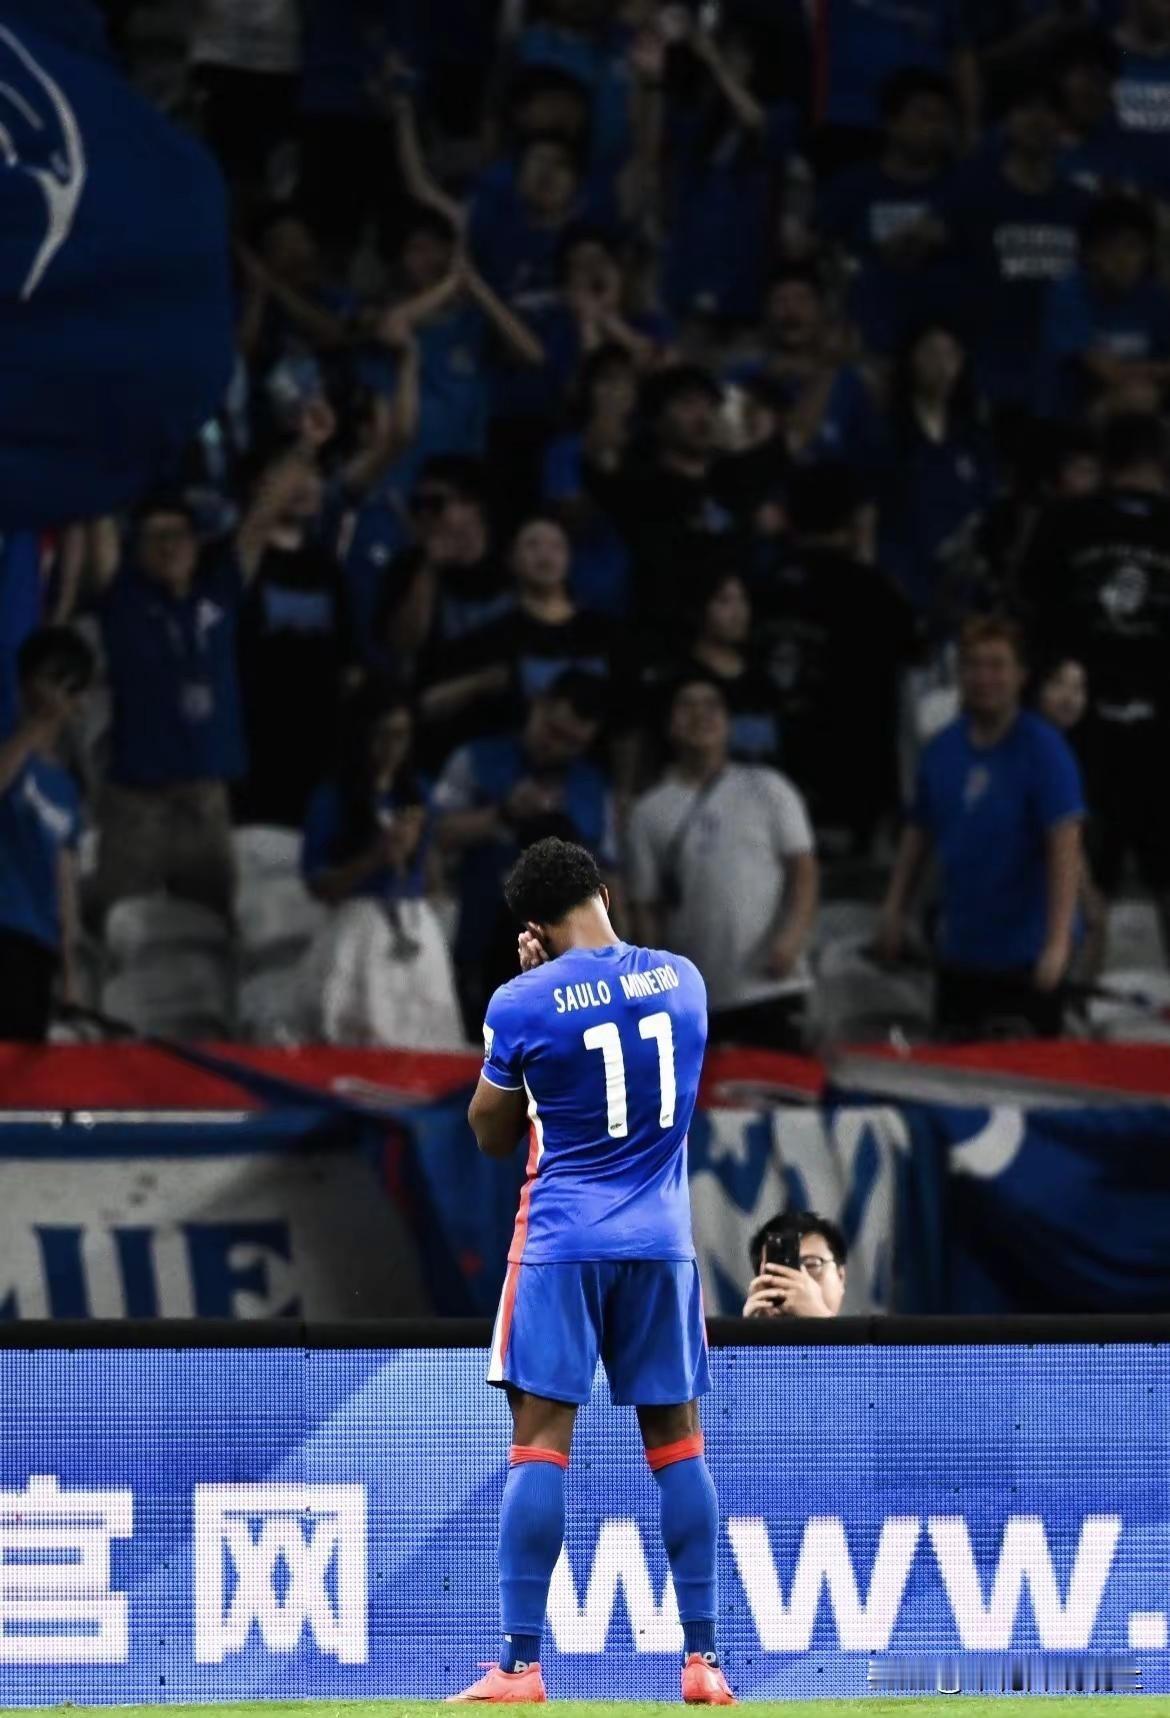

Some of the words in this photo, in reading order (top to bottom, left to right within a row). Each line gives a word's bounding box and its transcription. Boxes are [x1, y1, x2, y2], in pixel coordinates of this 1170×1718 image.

[553, 980, 612, 1013] SAULO
[620, 964, 679, 1000] MINEIRO
[583, 1011, 676, 1138] 11
[0, 1475, 368, 1664] 官网
